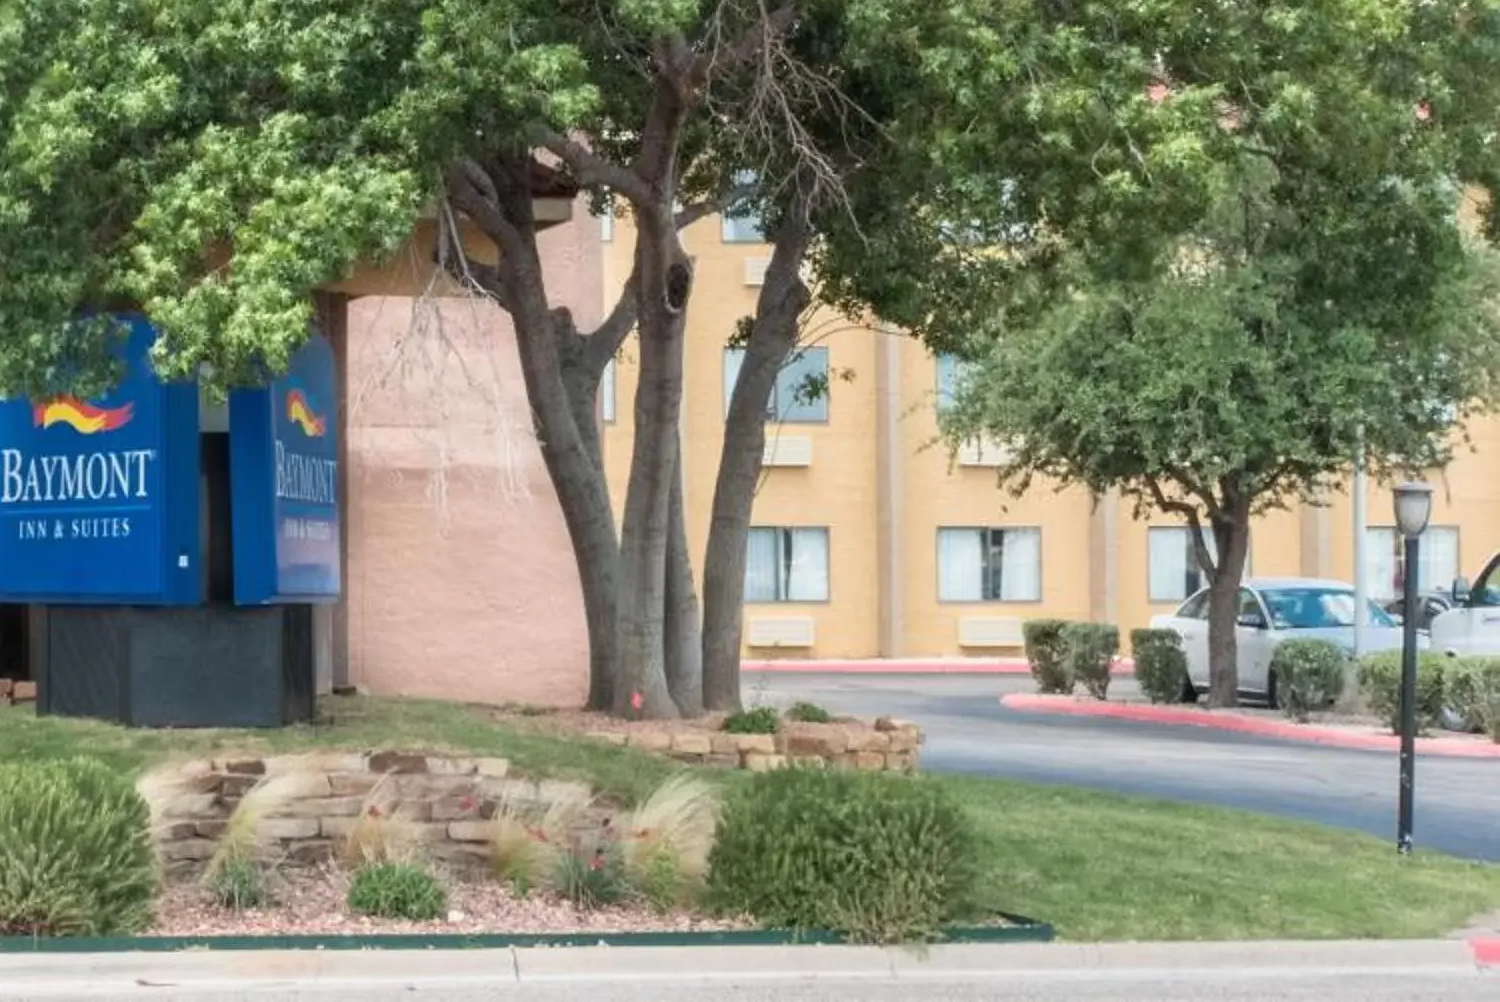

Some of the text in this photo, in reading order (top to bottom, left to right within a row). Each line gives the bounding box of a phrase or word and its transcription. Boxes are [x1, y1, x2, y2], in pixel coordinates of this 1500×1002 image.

[1, 448, 152, 502] BAYMONT
[276, 439, 337, 503] BAYMONT
[19, 517, 132, 539] INN & SUITES
